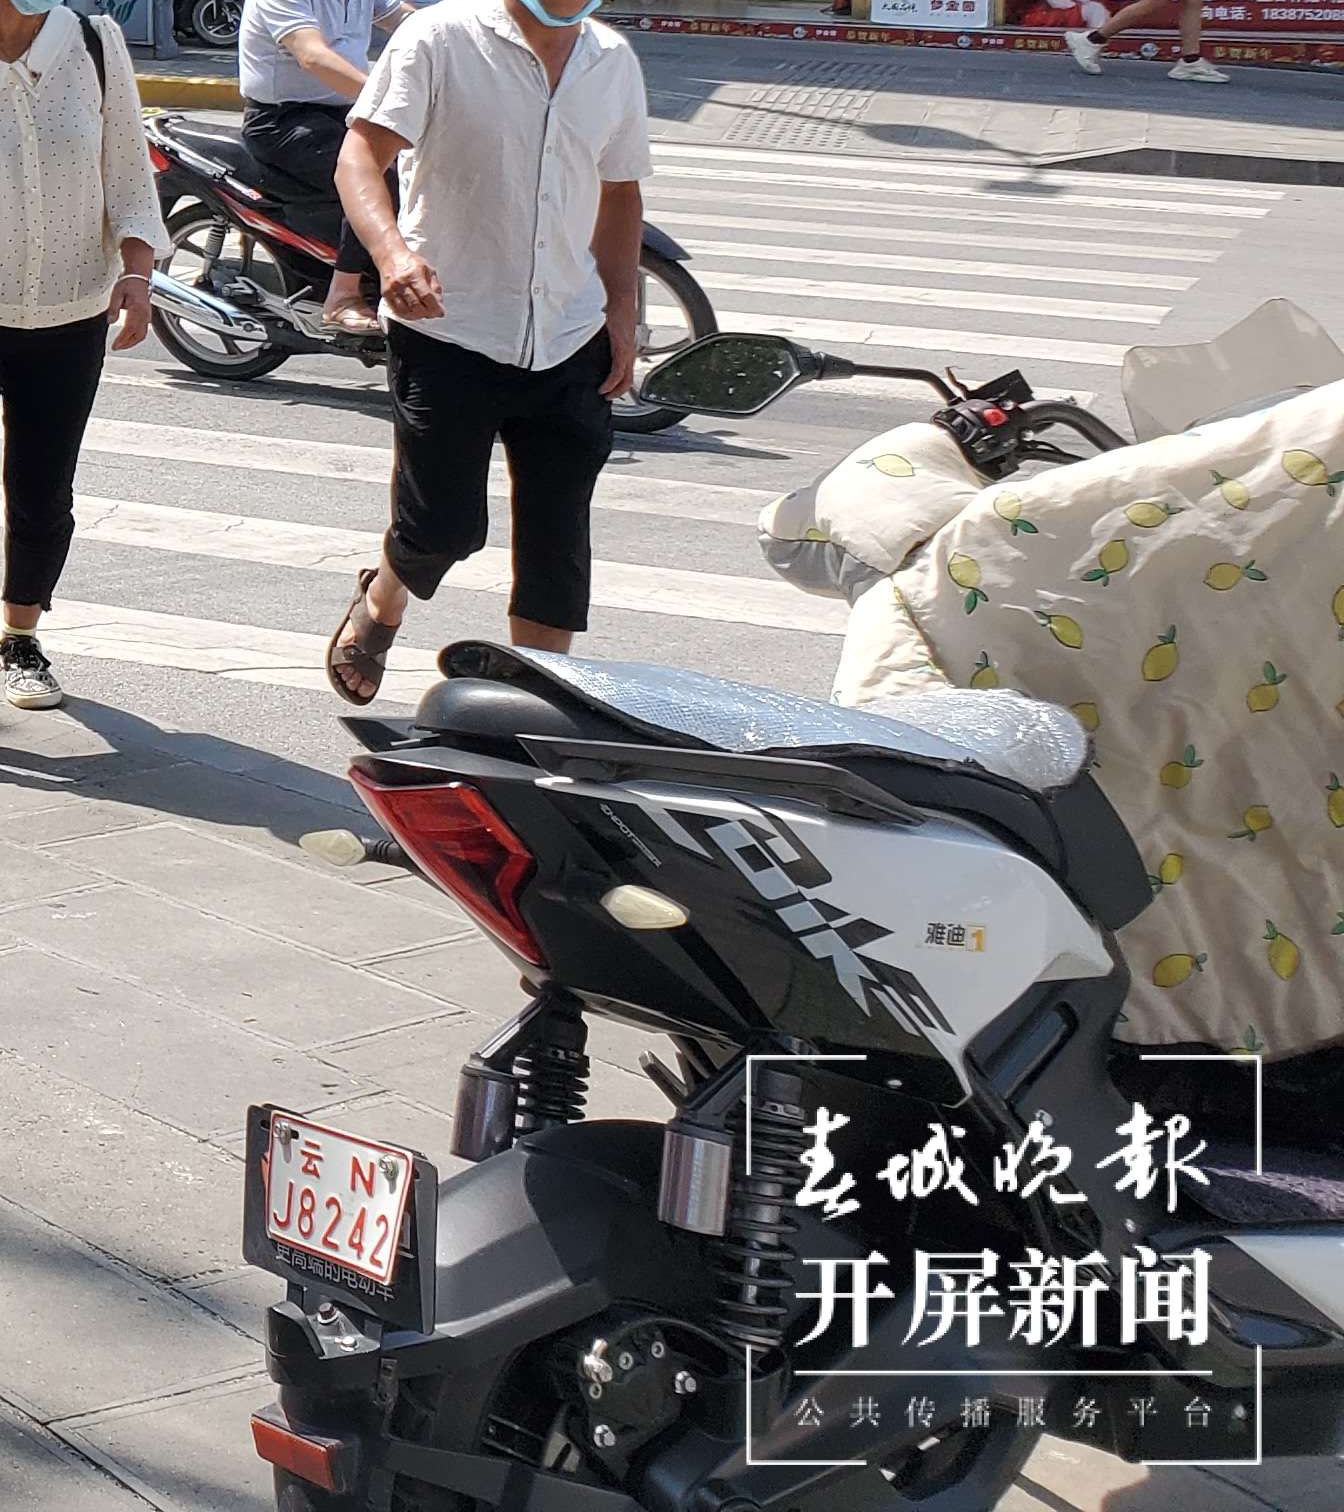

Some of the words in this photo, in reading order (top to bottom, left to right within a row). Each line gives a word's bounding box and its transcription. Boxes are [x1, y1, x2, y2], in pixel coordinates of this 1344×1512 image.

[300, 1140, 324, 1179] 云
[350, 1154, 376, 1198] N
[273, 1180, 389, 1269] J8242
